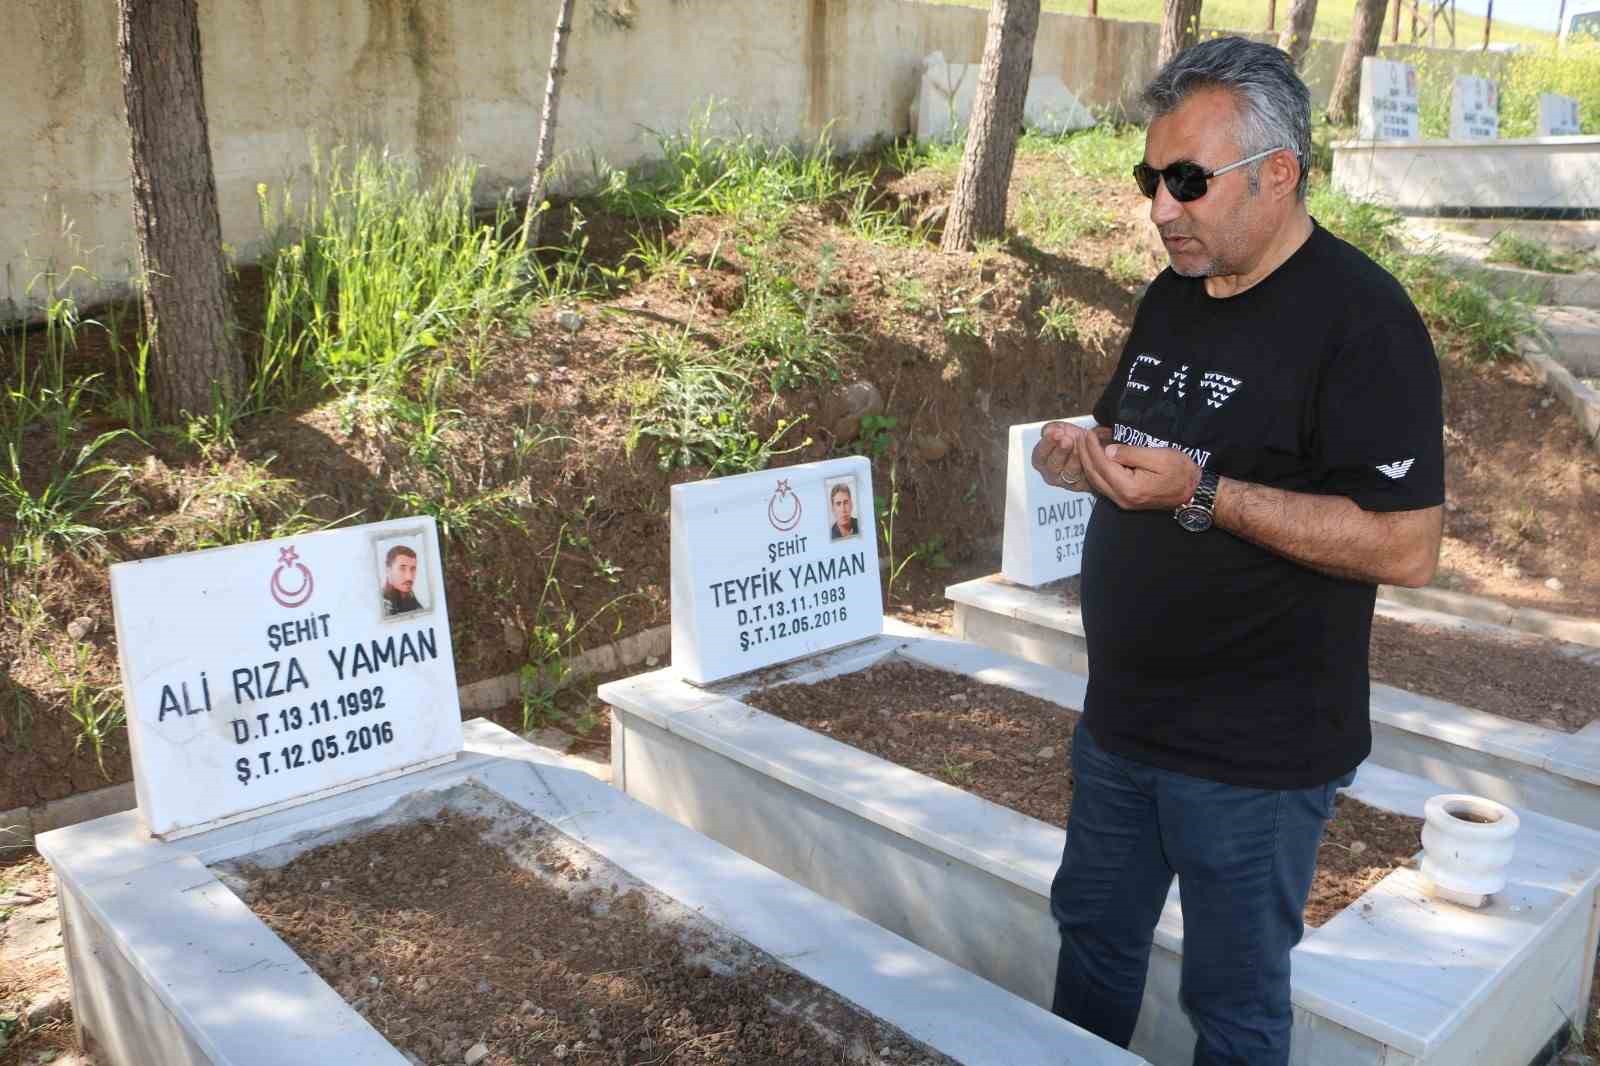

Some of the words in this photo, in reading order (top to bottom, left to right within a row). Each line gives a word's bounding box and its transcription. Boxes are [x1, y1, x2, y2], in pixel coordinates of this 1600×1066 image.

[1038, 498, 1084, 527] DAVUT
[768, 534, 808, 564] ŞEHİT
[709, 567, 784, 608] TEYFİK
[789, 552, 865, 589] YAMAN
[267, 613, 331, 651] ŞEHİT
[158, 671, 212, 722] ALİ
[232, 657, 310, 704] RIZA
[327, 627, 439, 681] YAMAN
